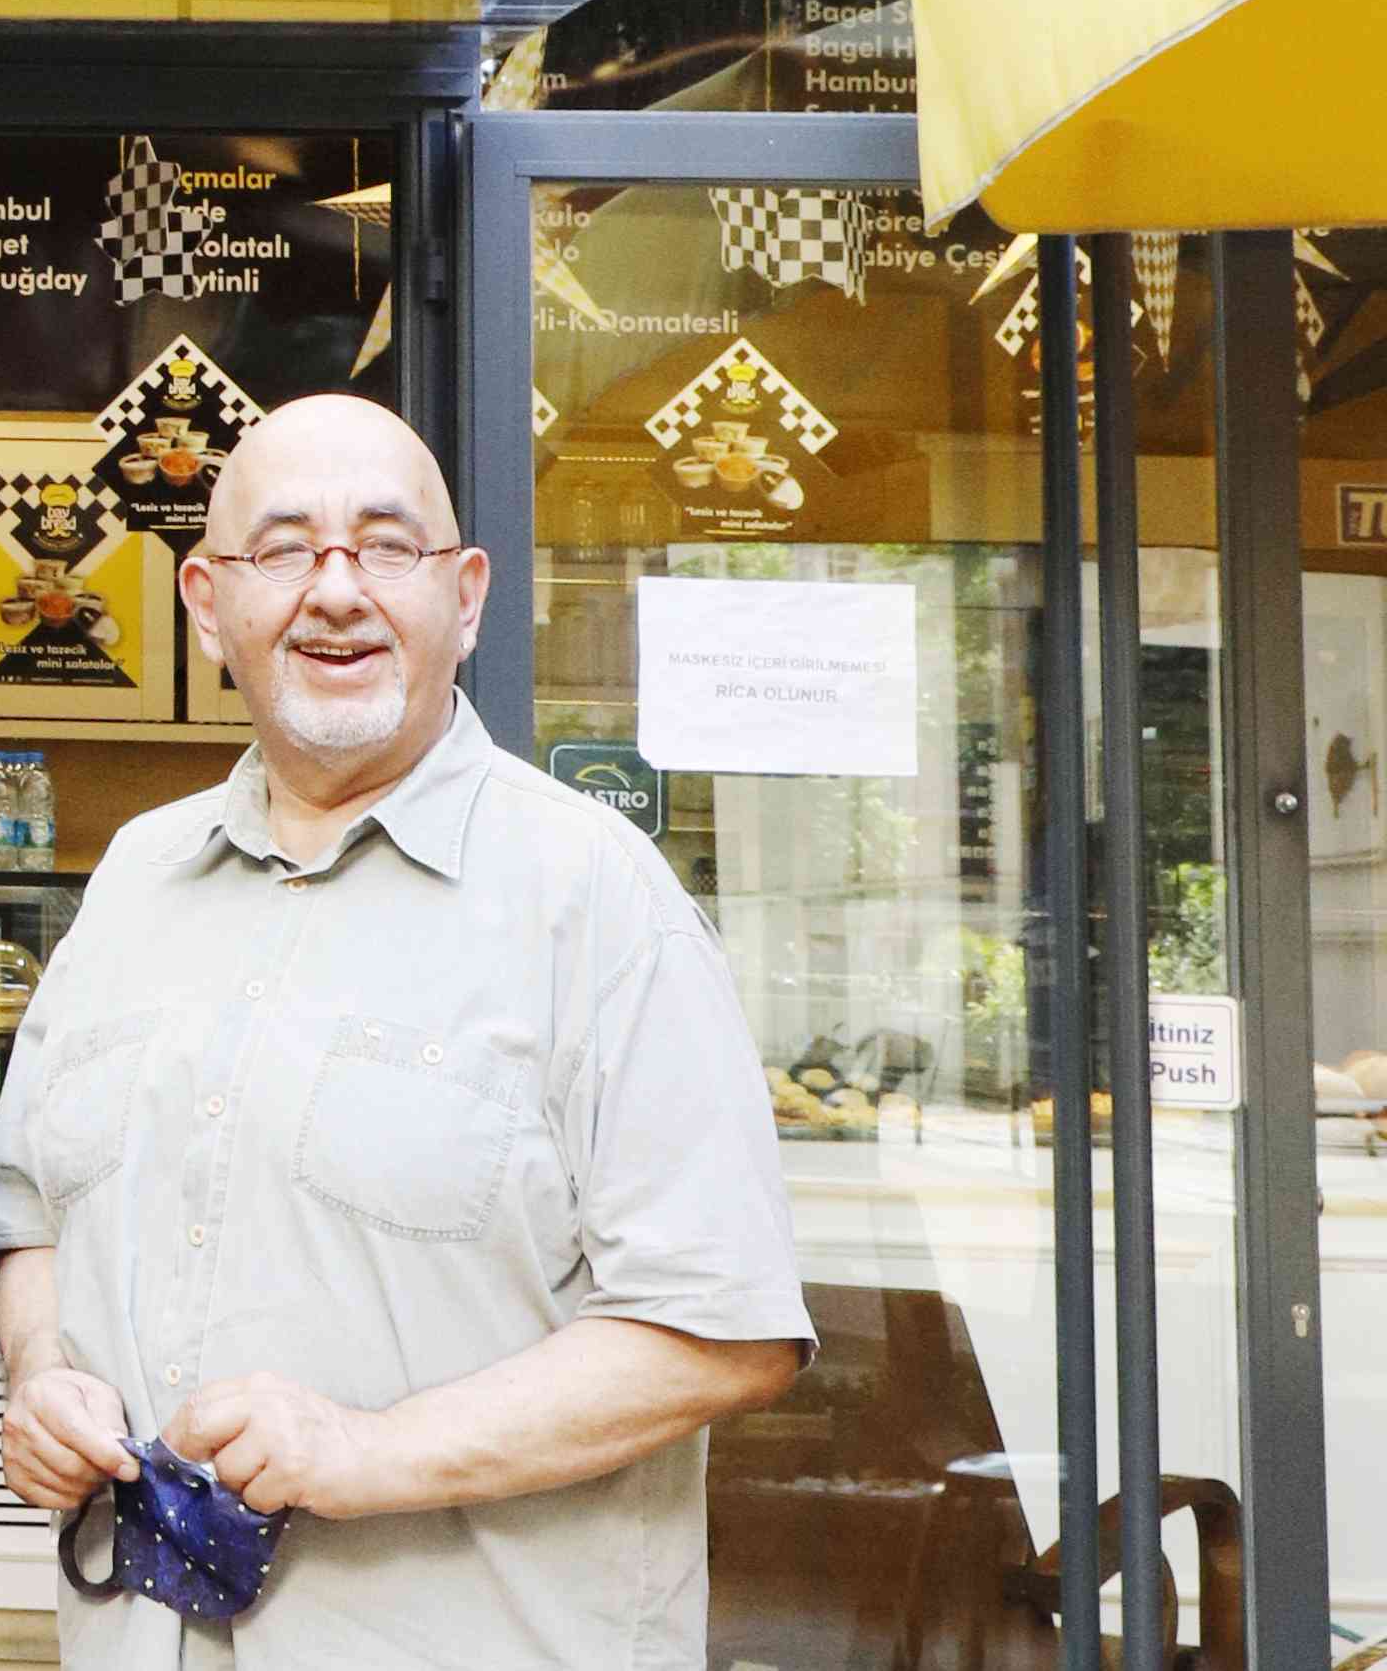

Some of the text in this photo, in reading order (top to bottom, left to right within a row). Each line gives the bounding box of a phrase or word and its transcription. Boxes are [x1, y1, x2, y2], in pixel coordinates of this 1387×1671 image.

[806, 0, 883, 28] Bagel
[805, 35, 883, 63] Bagel
[805, 69, 916, 93] Hambur
[177, 164, 277, 195] çmalar
[193, 267, 260, 298] ytinli
[1149, 1060, 1216, 1085] Push
